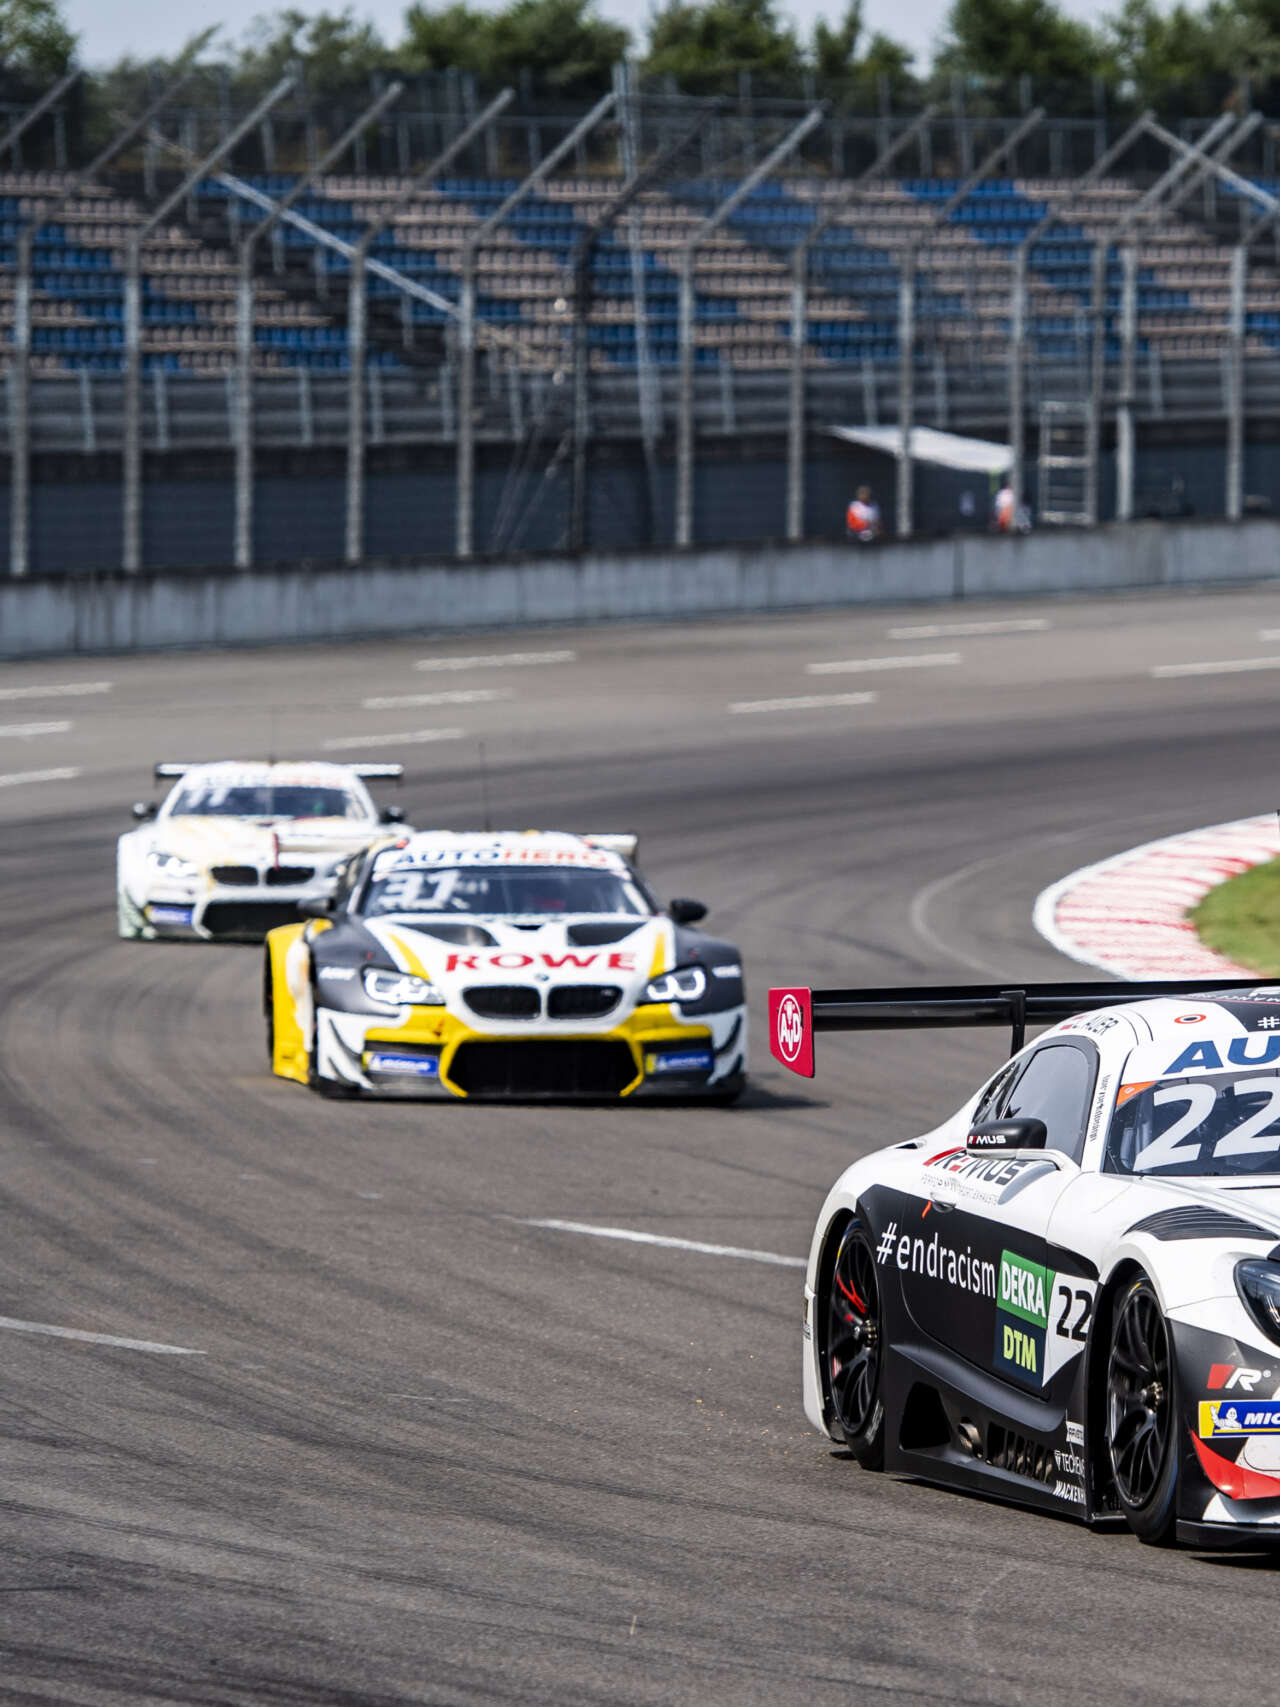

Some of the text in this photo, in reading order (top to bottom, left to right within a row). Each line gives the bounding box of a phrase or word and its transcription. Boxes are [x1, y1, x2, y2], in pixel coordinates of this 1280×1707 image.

[395, 849, 607, 864] AUTOHERO
[446, 953, 636, 972] ROWE
[876, 1222, 997, 1299] #endracism
[1002, 1260, 1047, 1318] DEKRA
[1055, 1285, 1093, 1342] 22
[1003, 1324, 1037, 1373] DTM
[1225, 1367, 1262, 1391] R
